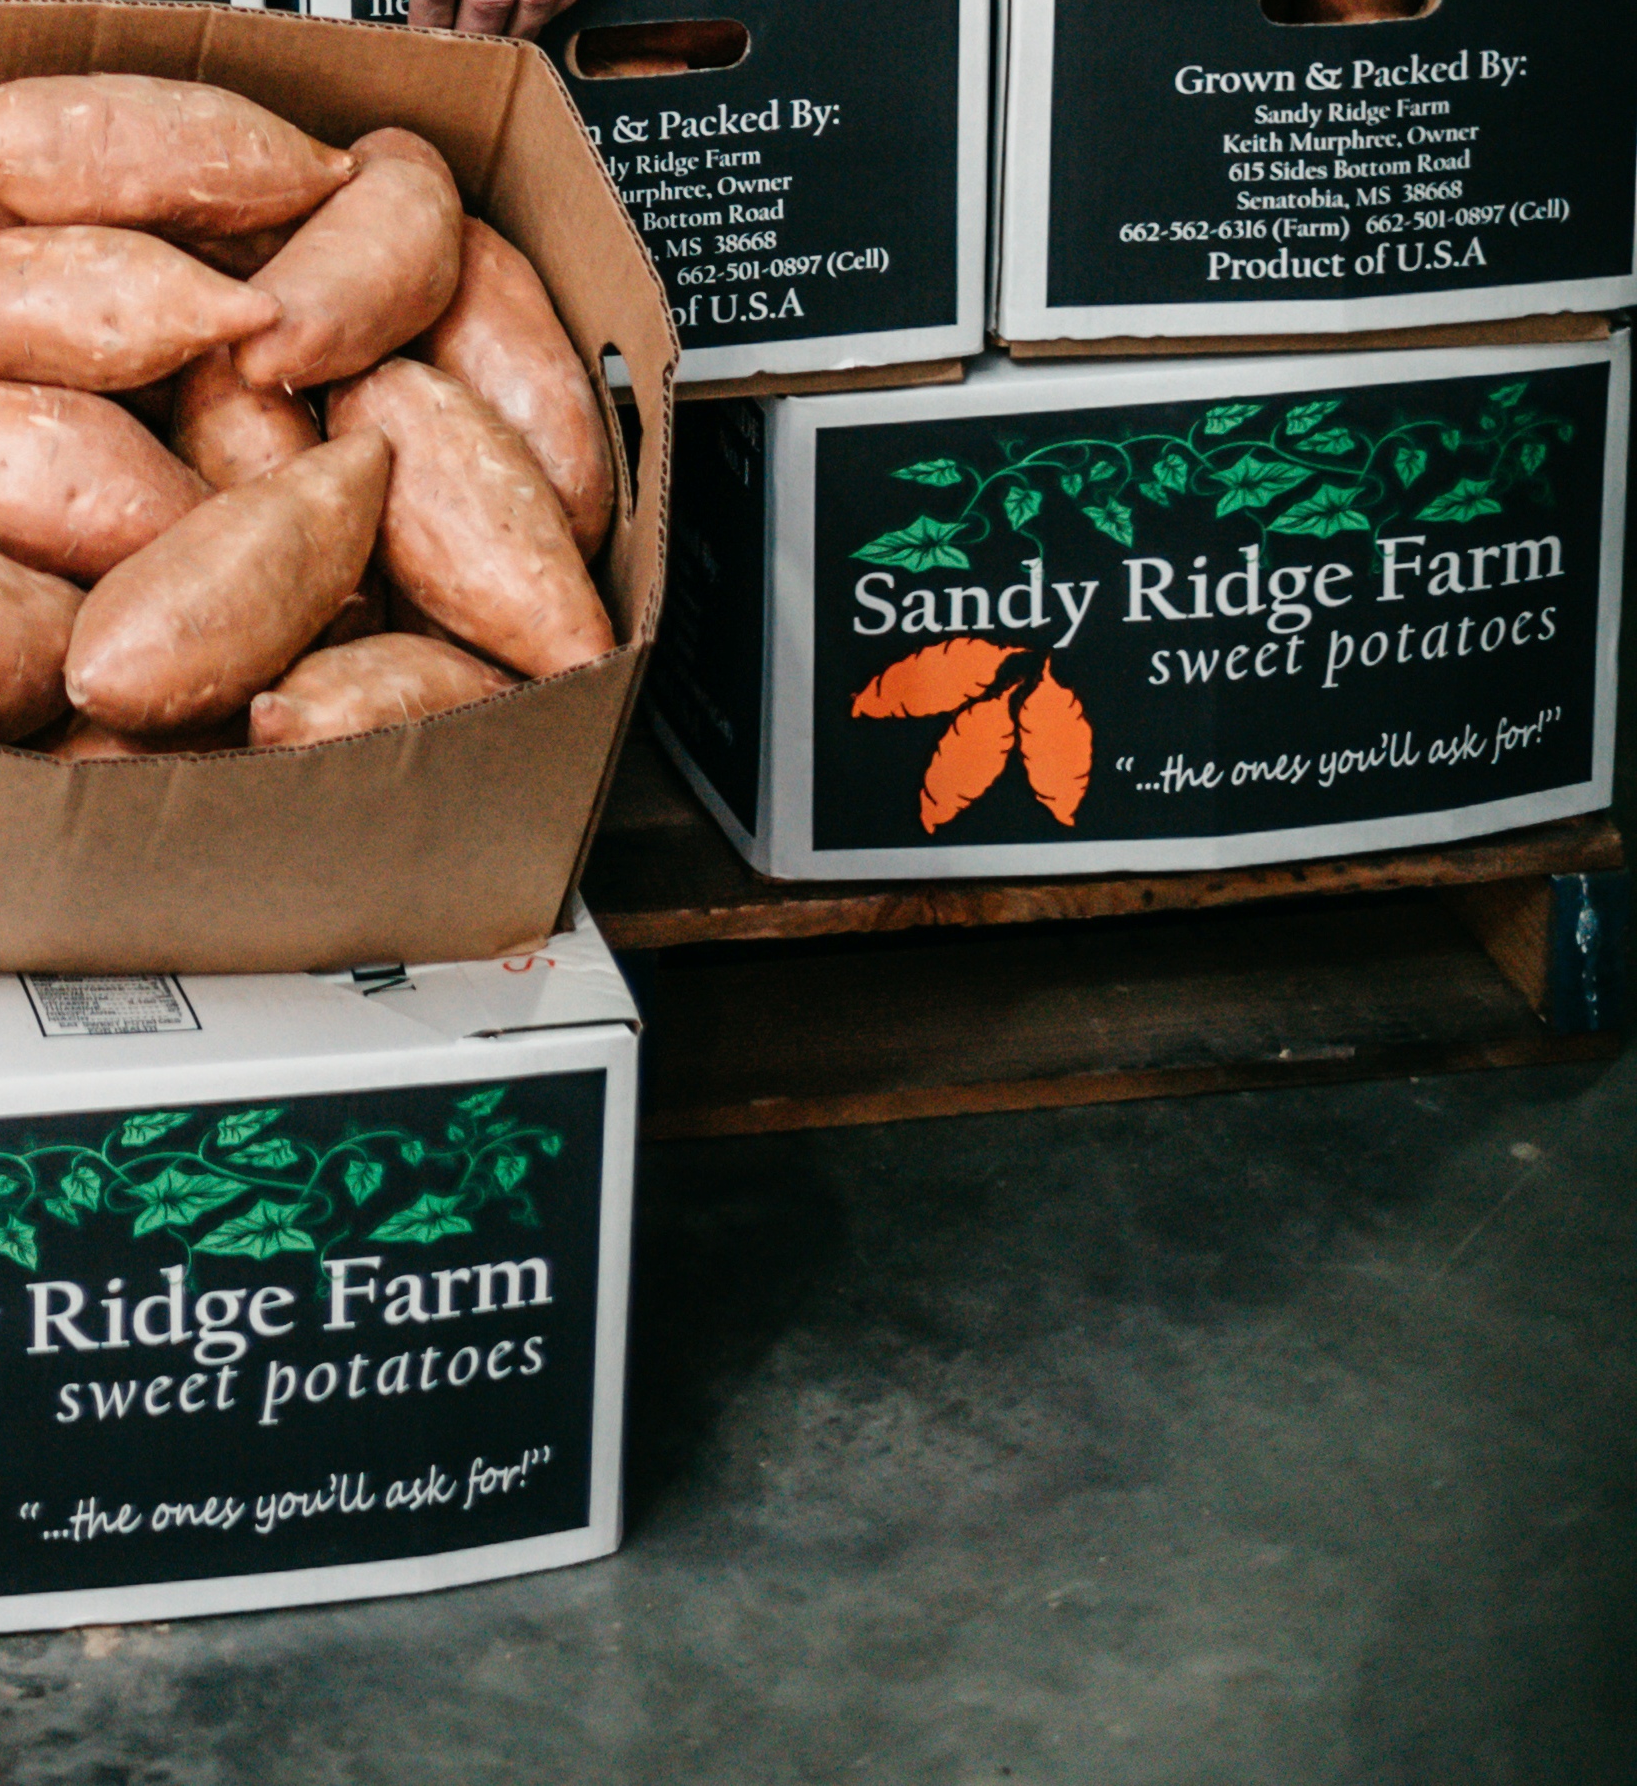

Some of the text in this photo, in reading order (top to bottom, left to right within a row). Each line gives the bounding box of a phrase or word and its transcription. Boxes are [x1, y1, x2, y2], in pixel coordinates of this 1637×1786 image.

[1174, 49, 1529, 96] Grown & Packed By:
[613, 115, 648, 144] &
[659, 98, 781, 140] Packed
[790, 98, 841, 137] By:
[1254, 96, 1451, 129] Sandy Ridge Farm
[1222, 122, 1480, 158] Keith Murphree, Owner
[636, 149, 699, 177] Ridge
[705, 148, 762, 169] Farm
[1227, 147, 1472, 183] 615 Sides Bottom Road
[615, 175, 792, 208] urphree, Owner
[1236, 179, 1463, 212] Senatobia, MS 38668
[643, 209, 722, 232] Bottom
[728, 198, 785, 224] Road
[1119, 197, 1572, 244] 662-562-6316 (Farm) 662-501-0897 (Cell)
[666, 237, 702, 259] MS
[714, 231, 778, 255] 38668
[1207, 235, 1487, 281] Product of U.S.A
[677, 247, 890, 286] 662-501-0897 (Cell)
[710, 287, 805, 324] U.S.A
[852, 531, 1566, 651] Sandy Ridge Farm
[1149, 606, 1560, 688] sweet potatoes
[1230, 751, 1310, 785] ones
[1427, 727, 1489, 765] ask
[24, 1266, 297, 1368] Ridge
[322, 1252, 554, 1331] Farm
[56, 1333, 547, 1426] sweet potatoes
[150, 1492, 246, 1531] ones
[383, 1466, 456, 1508] ask
